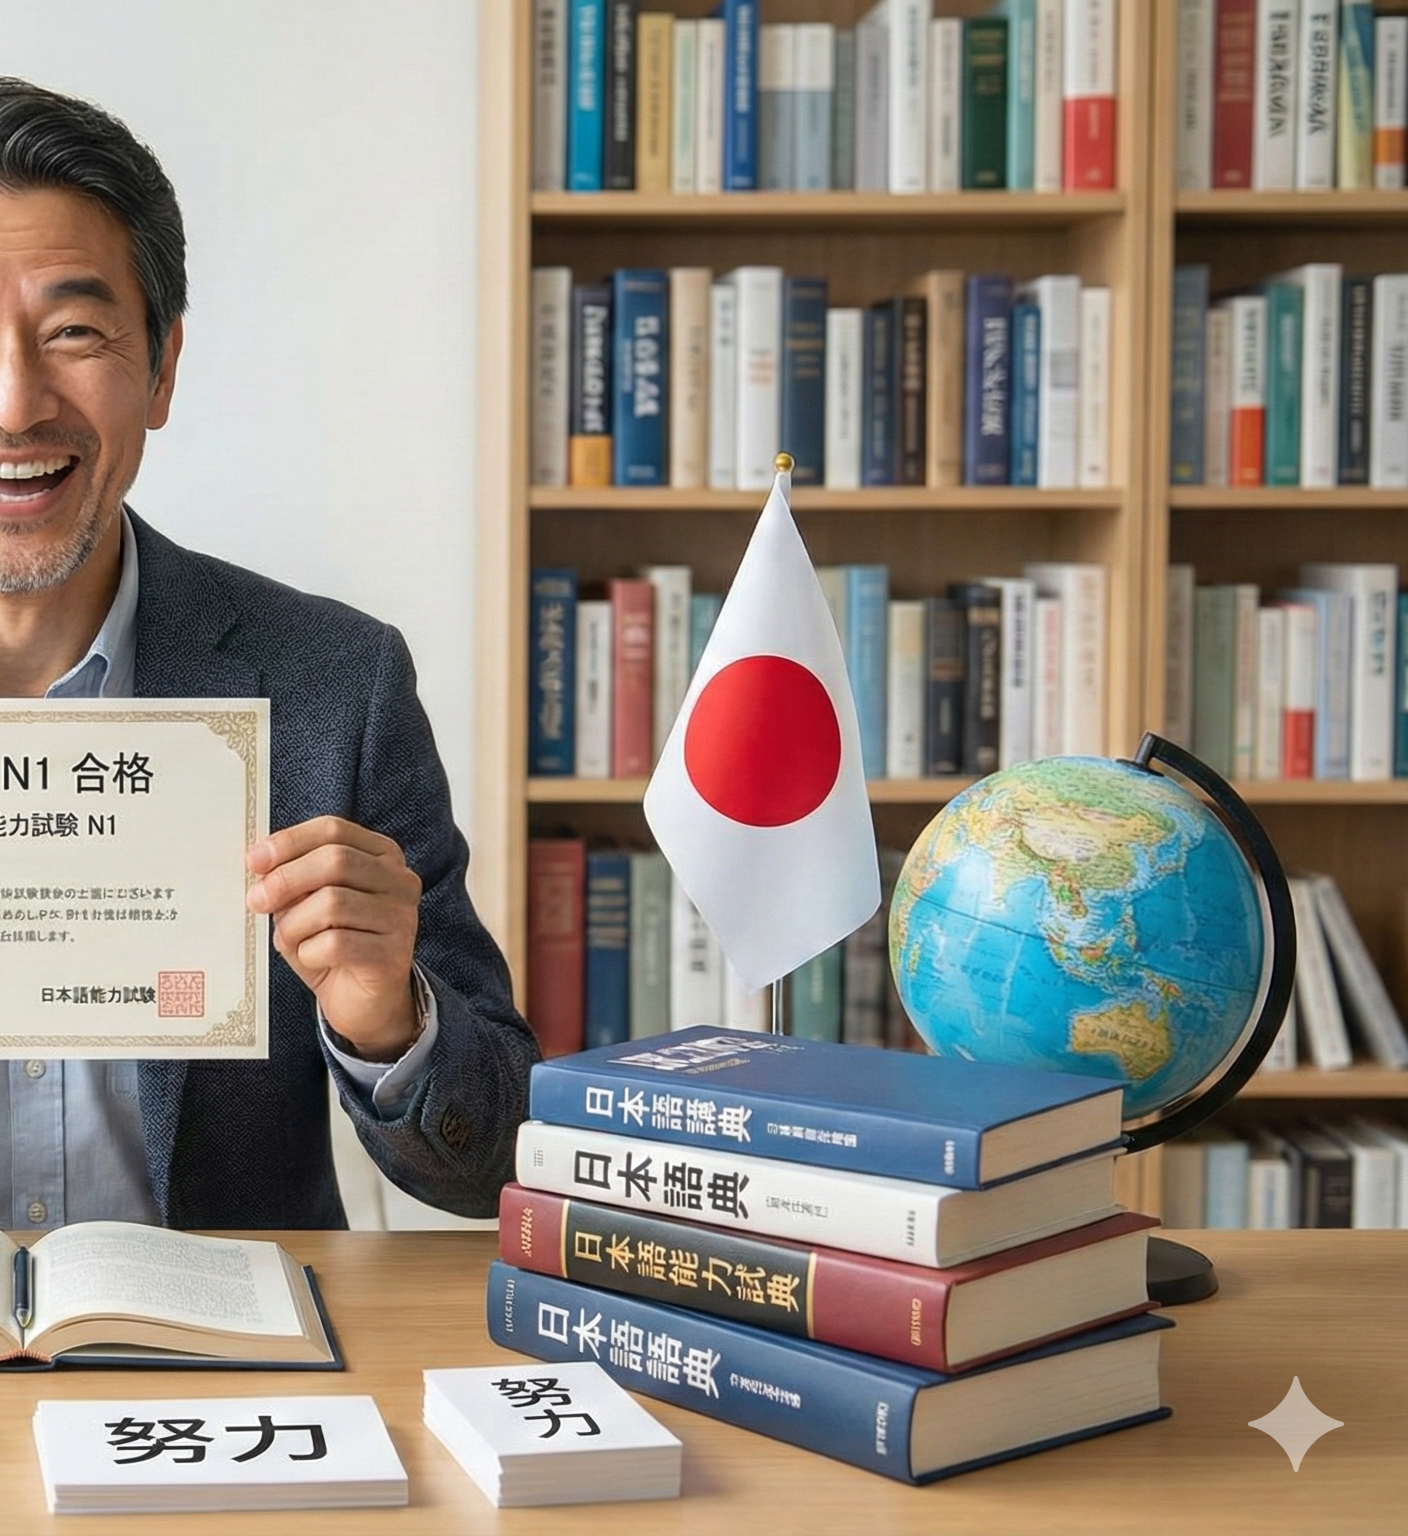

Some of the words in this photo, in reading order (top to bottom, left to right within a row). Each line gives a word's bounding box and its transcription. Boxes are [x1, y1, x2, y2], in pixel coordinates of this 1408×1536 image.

[3, 757, 49, 790] N1
[72, 753, 154, 794] 合格
[88, 815, 115, 835] N1
[41, 985, 156, 1004] 日本語能力試験
[574, 1150, 750, 1219] 日本語典
[574, 1231, 801, 1313] 日本語能力試典
[538, 1302, 721, 1399] 日本語語典
[490, 1376, 602, 1440] 努力
[104, 1415, 328, 1465] 努力
